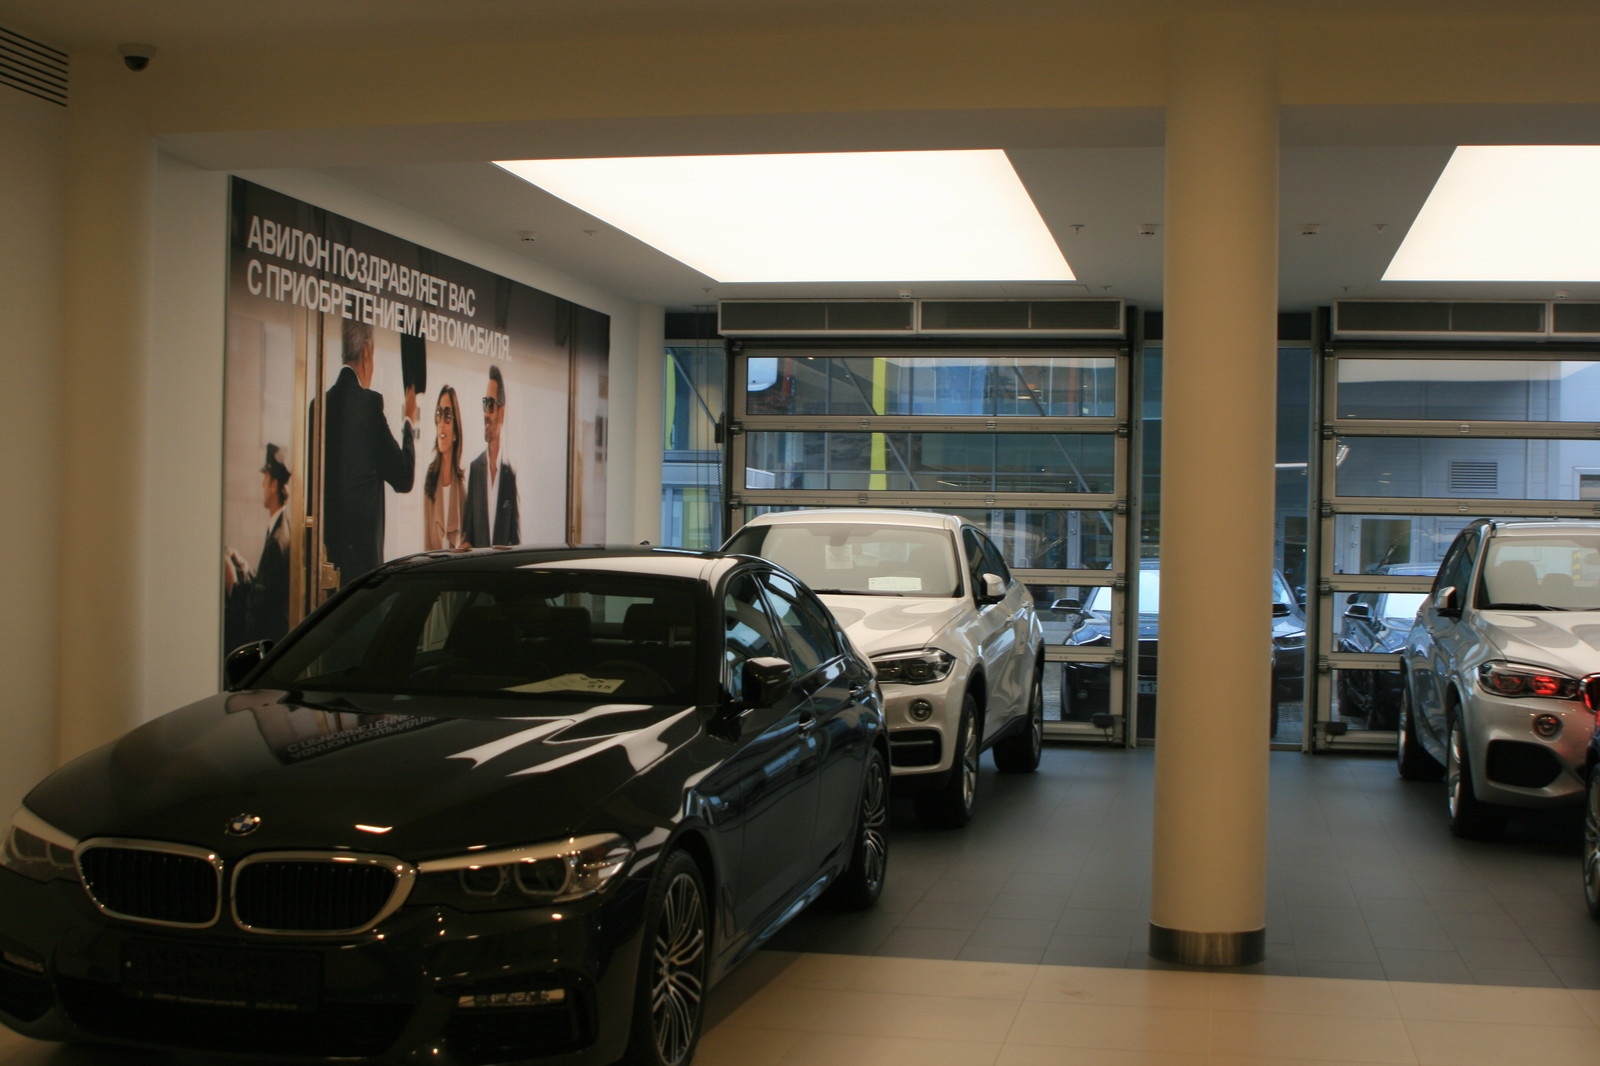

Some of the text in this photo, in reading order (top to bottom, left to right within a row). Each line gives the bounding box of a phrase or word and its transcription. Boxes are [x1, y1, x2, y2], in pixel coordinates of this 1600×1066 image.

[246, 215, 476, 317] АВИЛОН ПОЗДРАВЛЯЕТ ВАС
[247, 259, 512, 362] С ПРИОБРЕТЕНИЕМ АВТОМОБИЛЯ.
